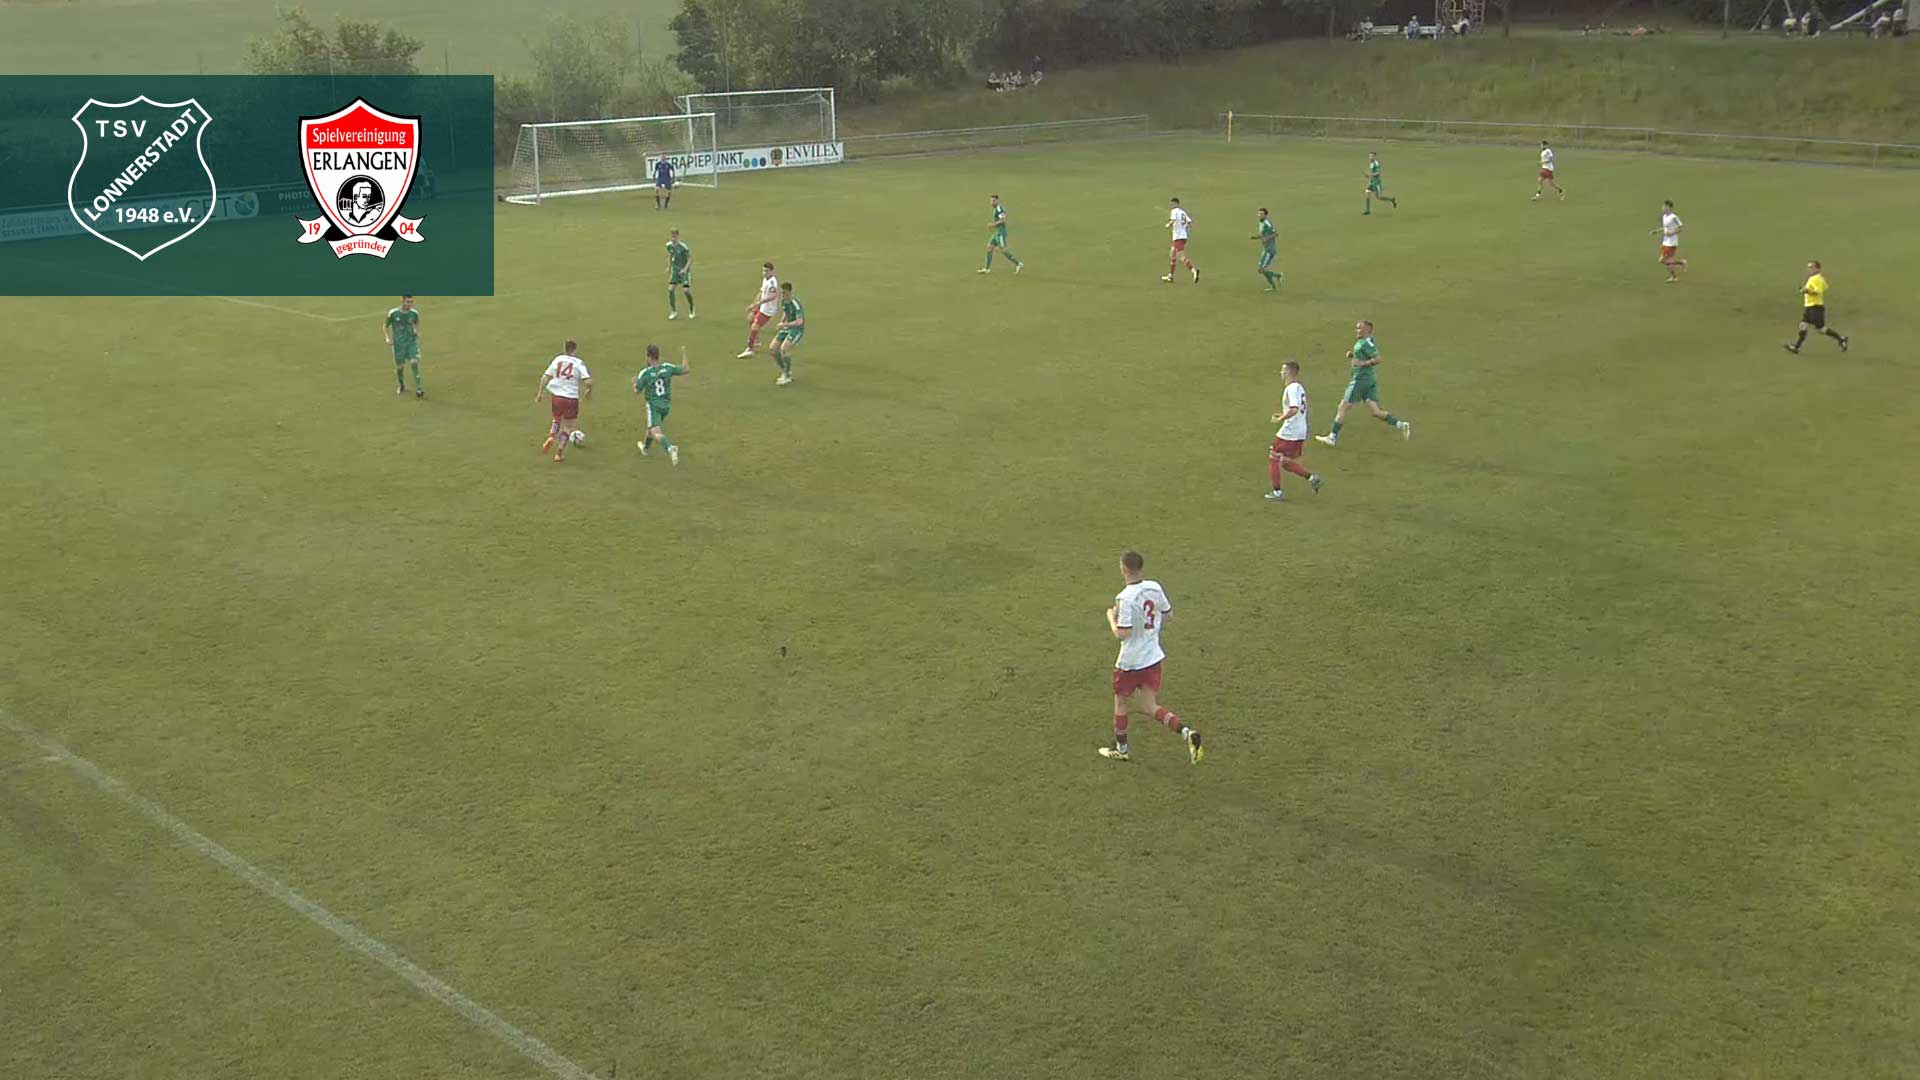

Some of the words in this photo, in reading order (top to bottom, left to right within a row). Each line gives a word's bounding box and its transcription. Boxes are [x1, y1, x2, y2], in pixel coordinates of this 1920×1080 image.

[647, 151, 744, 172] TRAPIEPUNKT
[786, 142, 840, 160] ENVILEX
[555, 360, 574, 381] 14
[654, 378, 666, 397] 8
[1143, 598, 1156, 630] 3
